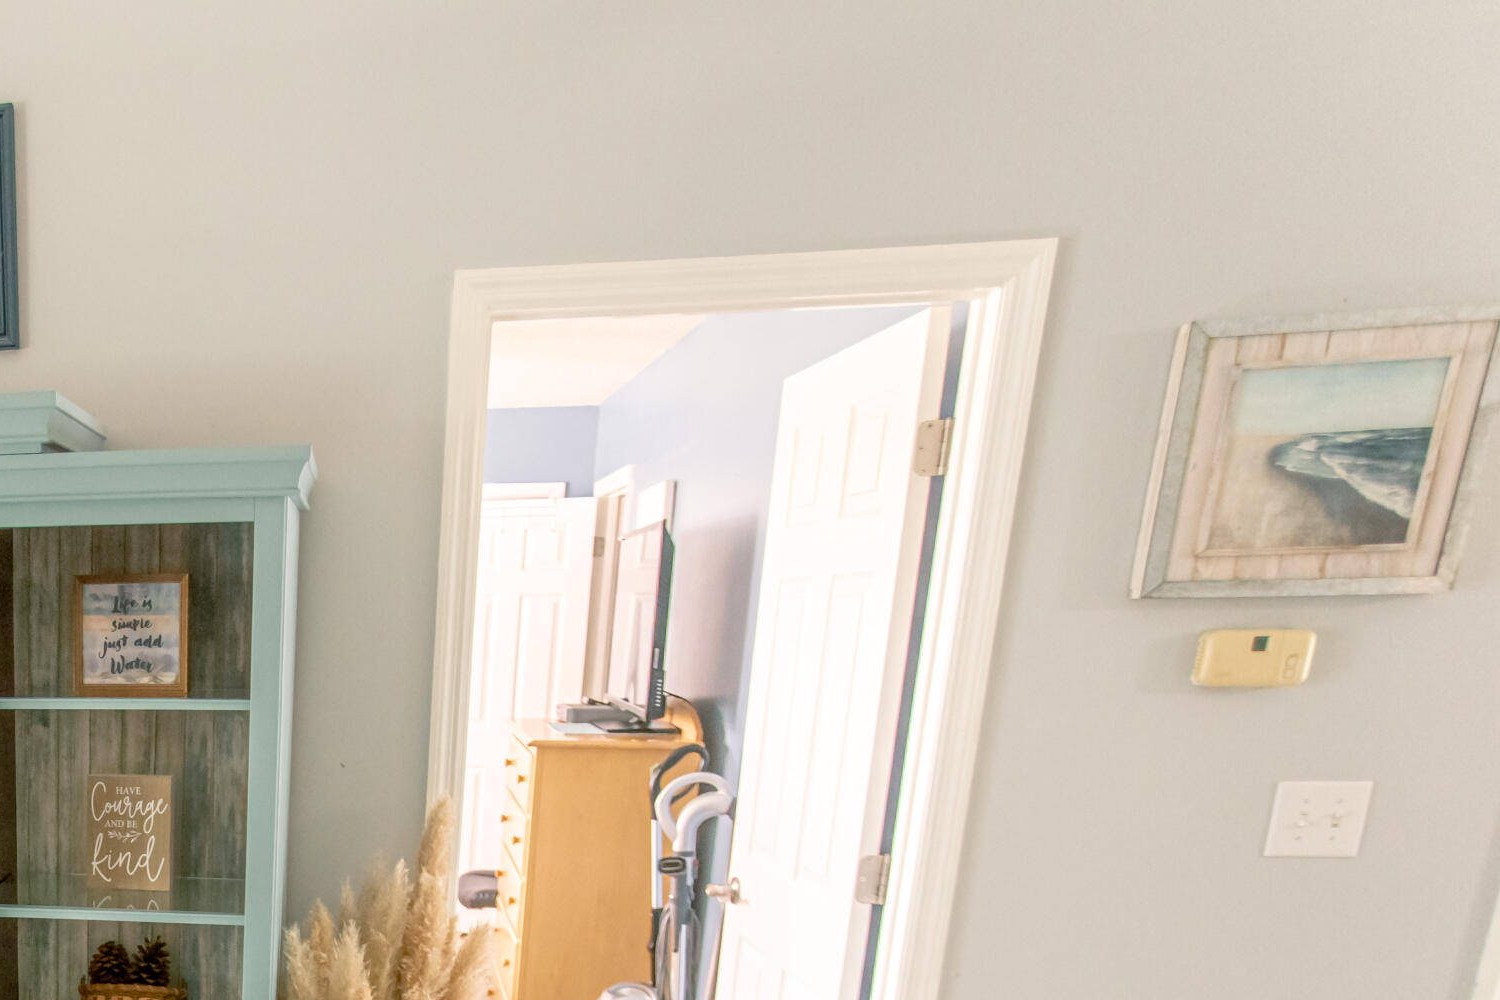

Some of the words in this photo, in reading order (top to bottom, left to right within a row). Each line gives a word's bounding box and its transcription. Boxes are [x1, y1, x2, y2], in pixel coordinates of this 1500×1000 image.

[111, 596, 139, 615] Life
[142, 595, 152, 612] is
[111, 617, 152, 632] simple
[99, 634, 129, 659] just
[134, 634, 164, 648] add
[111, 655, 153, 675] Water
[116, 786, 141, 796] HAVE
[91, 781, 168, 834] Courage
[105, 819, 125, 829] AND
[127, 819, 138, 829] BE
